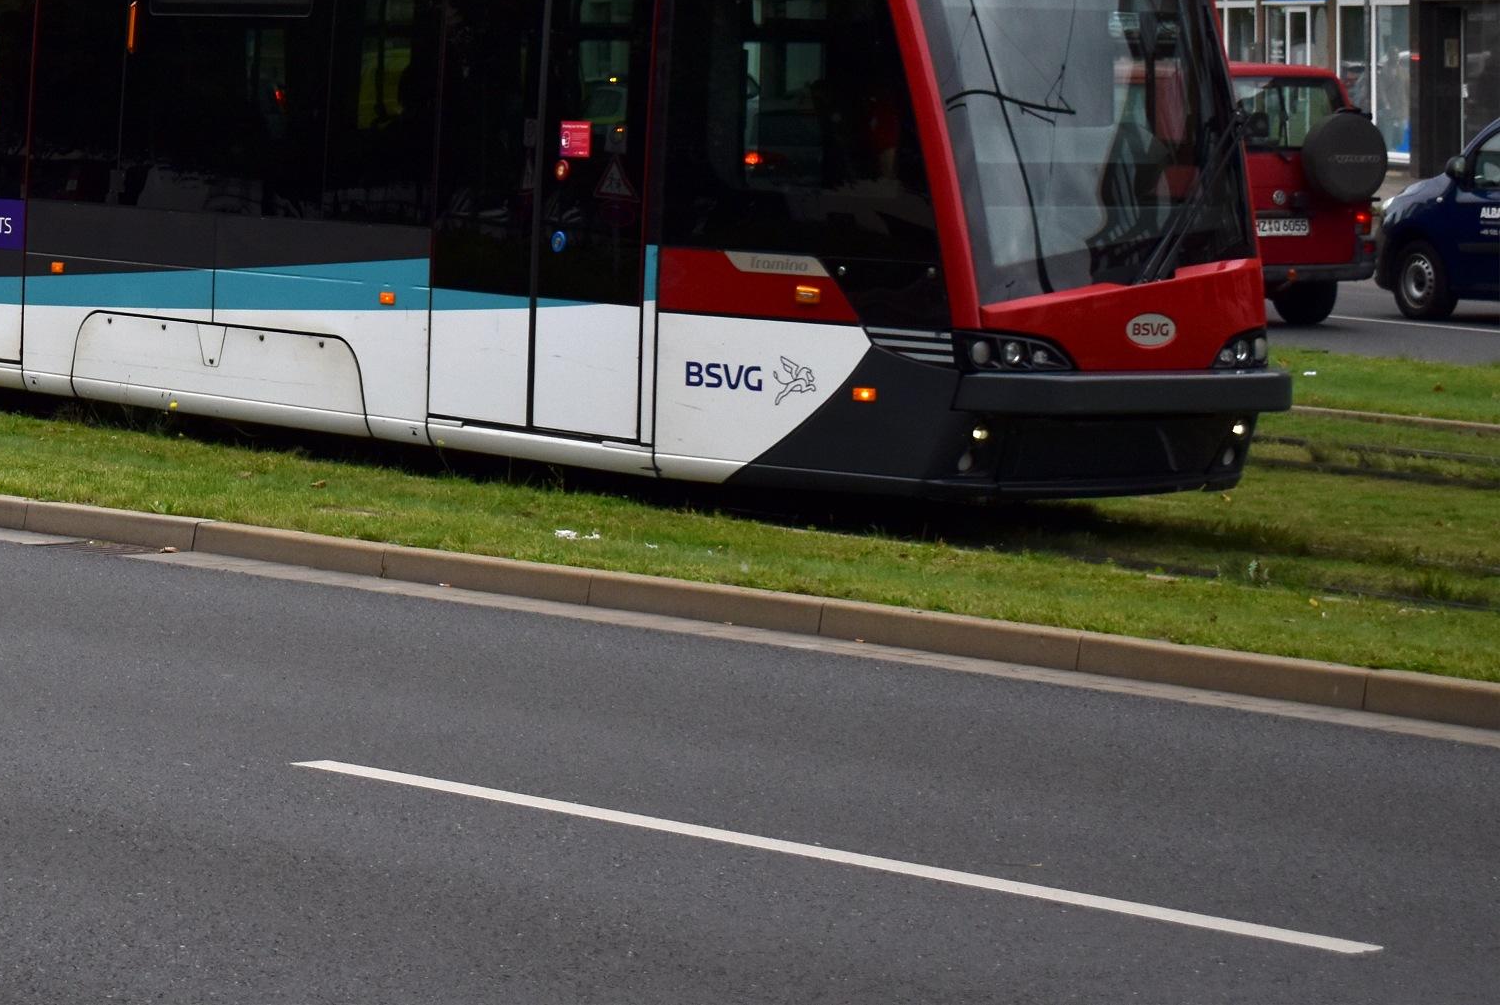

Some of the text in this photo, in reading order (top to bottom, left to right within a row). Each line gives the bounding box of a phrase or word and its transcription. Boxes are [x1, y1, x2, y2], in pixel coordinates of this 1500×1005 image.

[750, 256, 809, 273] Tramino
[1132, 322, 1170, 337] BSVG
[684, 360, 763, 392] BSVG
